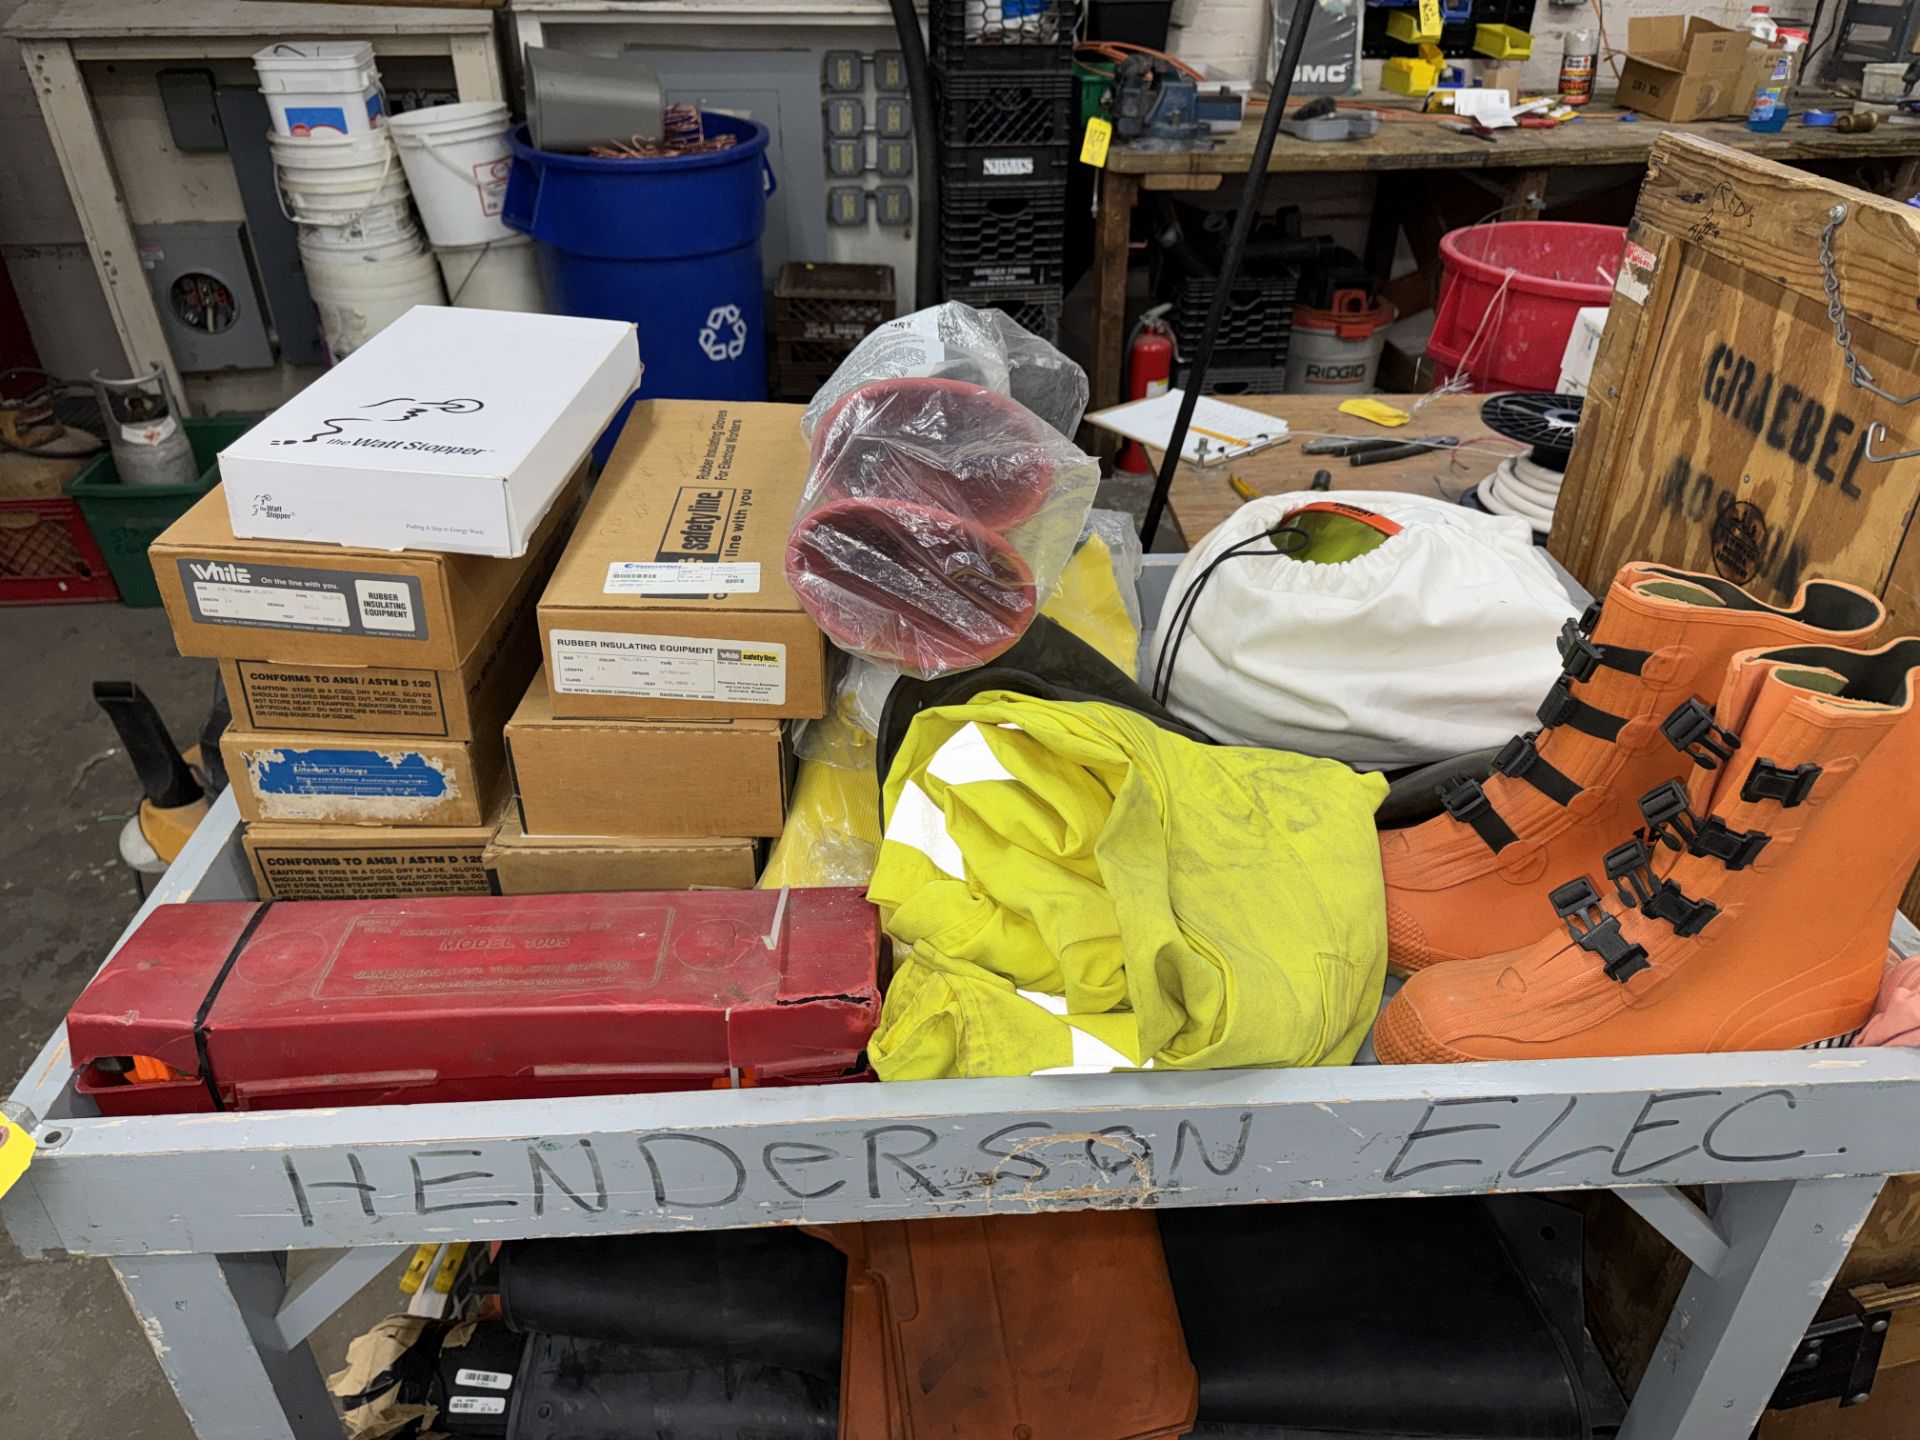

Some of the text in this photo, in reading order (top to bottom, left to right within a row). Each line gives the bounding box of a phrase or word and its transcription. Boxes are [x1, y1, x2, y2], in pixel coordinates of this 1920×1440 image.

[1305, 363, 1366, 379] RIDGID
[326, 437, 488, 456] the Watt Stopper
[696, 409, 728, 480] Rubber Insulating Gloves
[714, 419, 742, 481] For Electrical Workers
[267, 504, 282, 512] Watt
[266, 511, 291, 520] Stopper
[725, 488, 753, 557] line with you
[261, 577, 273, 585] On
[274, 578, 287, 586] the
[288, 579, 303, 587] line
[304, 580, 321, 588] with
[368, 592, 399, 601] RUBBER
[363, 600, 407, 611] INSULATING
[364, 608, 408, 619] EQUIPMENT
[557, 638, 714, 654] RUBBER INSULATING EQUIPMENT
[250, 672, 312, 683] CONFORMS
[315, 675, 331, 684] TO
[333, 676, 359, 685] ANSI
[368, 677, 399, 687] ASTM
[401, 679, 409, 687] D
[412, 680, 432, 688] 120
[251, 684, 289, 692] CAUTION:
[267, 857, 341, 866] CONFORMS
[366, 857, 398, 865] ANSI
[409, 856, 446, 864] ASTM
[440, 937, 517, 951] MODEL
[1383, 1088, 1847, 1182] ELEC.
